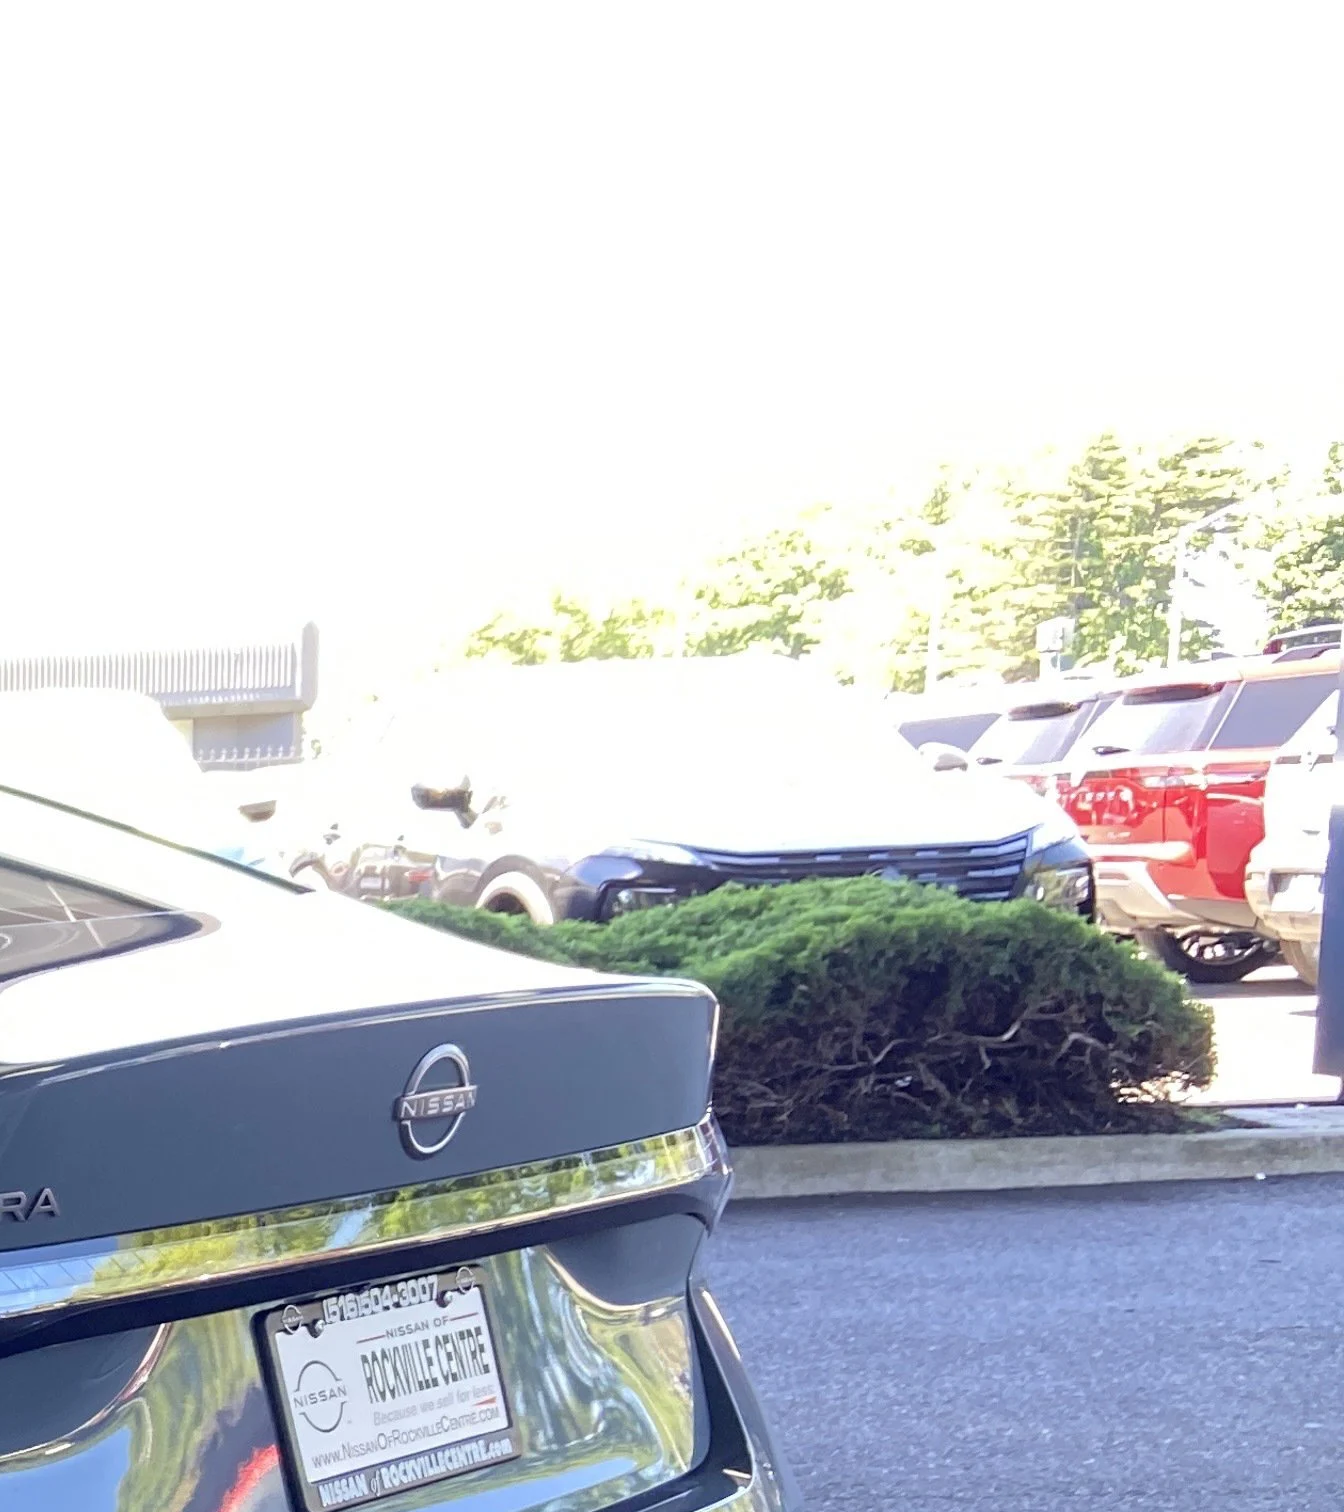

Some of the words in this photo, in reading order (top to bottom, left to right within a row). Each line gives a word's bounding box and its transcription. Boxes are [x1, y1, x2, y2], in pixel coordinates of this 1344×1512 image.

[400, 1091, 475, 1118] NISSAN
[385, 1320, 430, 1339] NISSAN
[433, 1316, 450, 1327] OF
[360, 1339, 439, 1404] ROCKVILLE
[434, 1326, 490, 1386] CENTRE
[293, 1384, 347, 1408] NISSAN
[318, 1474, 369, 1507] NISSAN
[370, 1470, 382, 1497] of
